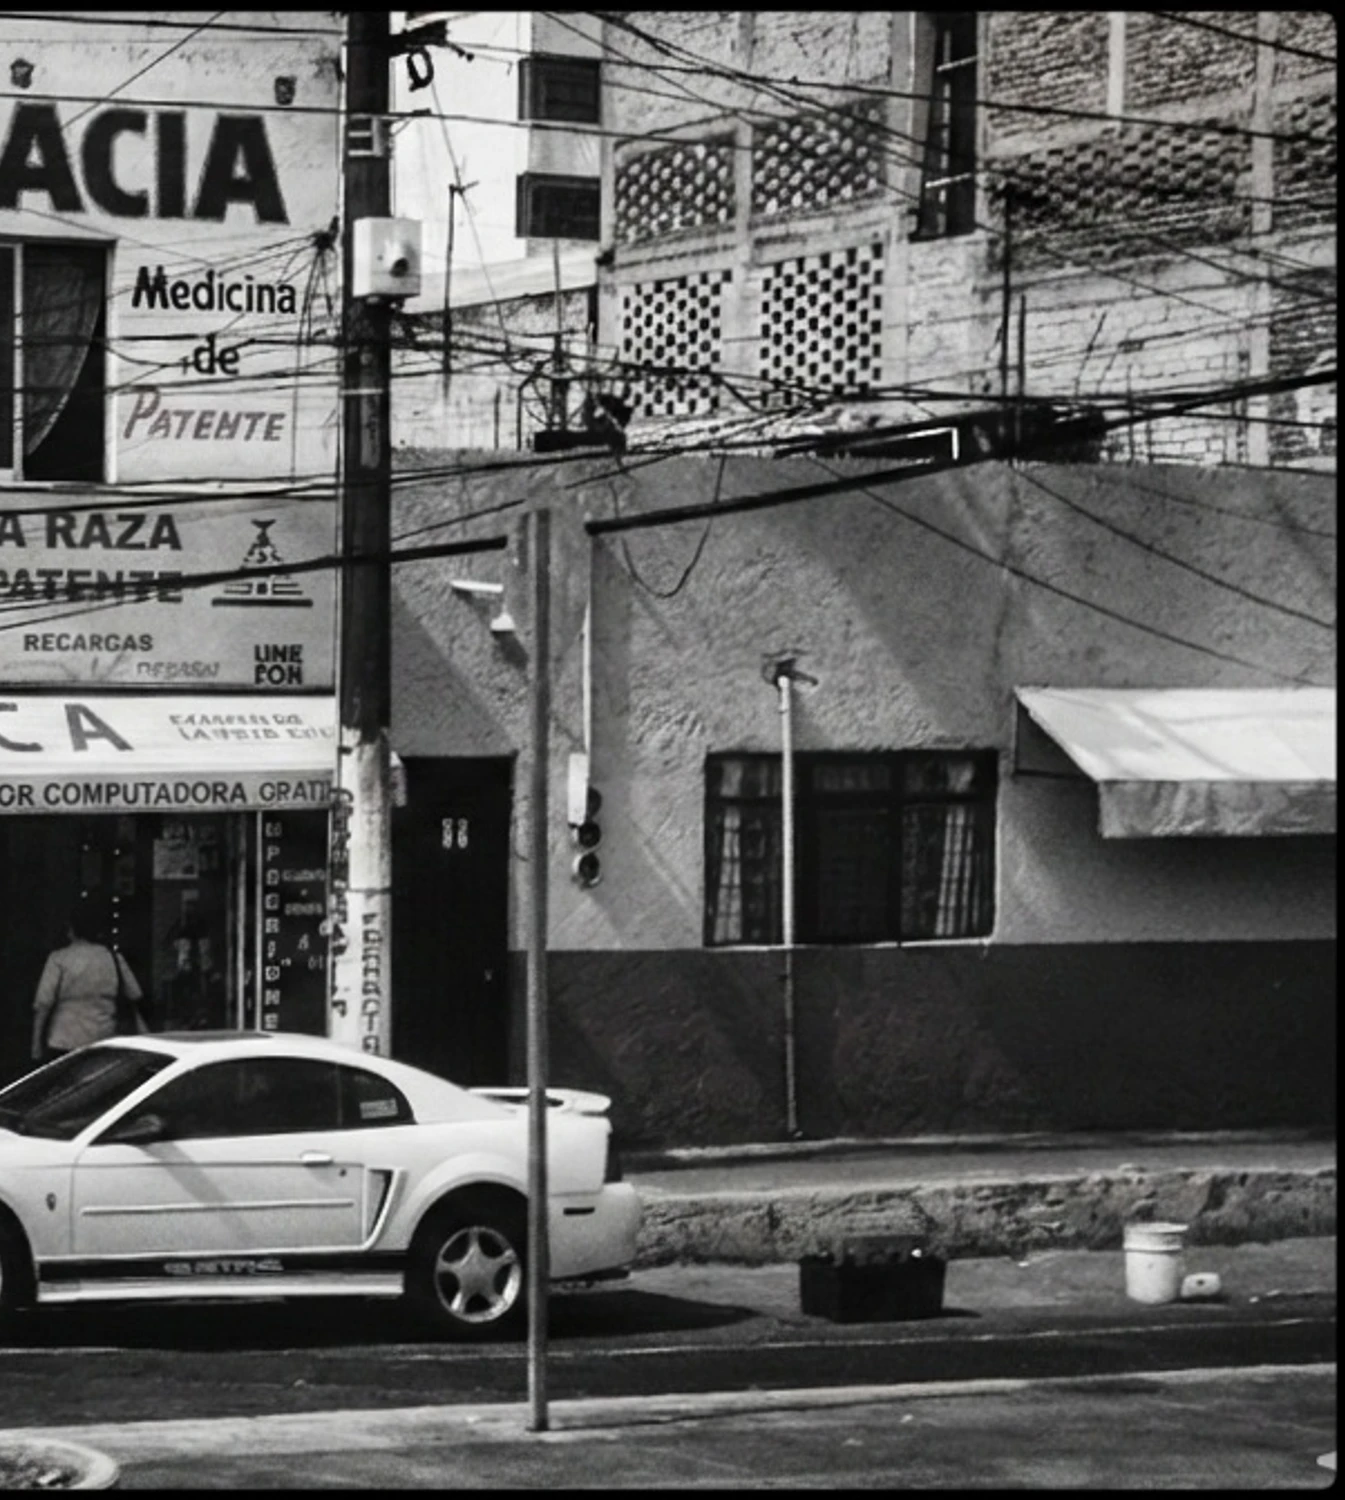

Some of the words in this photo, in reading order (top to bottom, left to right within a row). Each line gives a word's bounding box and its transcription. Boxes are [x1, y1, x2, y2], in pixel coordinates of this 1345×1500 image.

[131, 265, 296, 314] Medicina
[193, 332, 240, 375] de
[123, 388, 286, 442] PATENTE
[46, 511, 183, 551] RAZA
[23, 634, 154, 652] RECARGAS
[43, 781, 247, 805] COMPUTADORA
